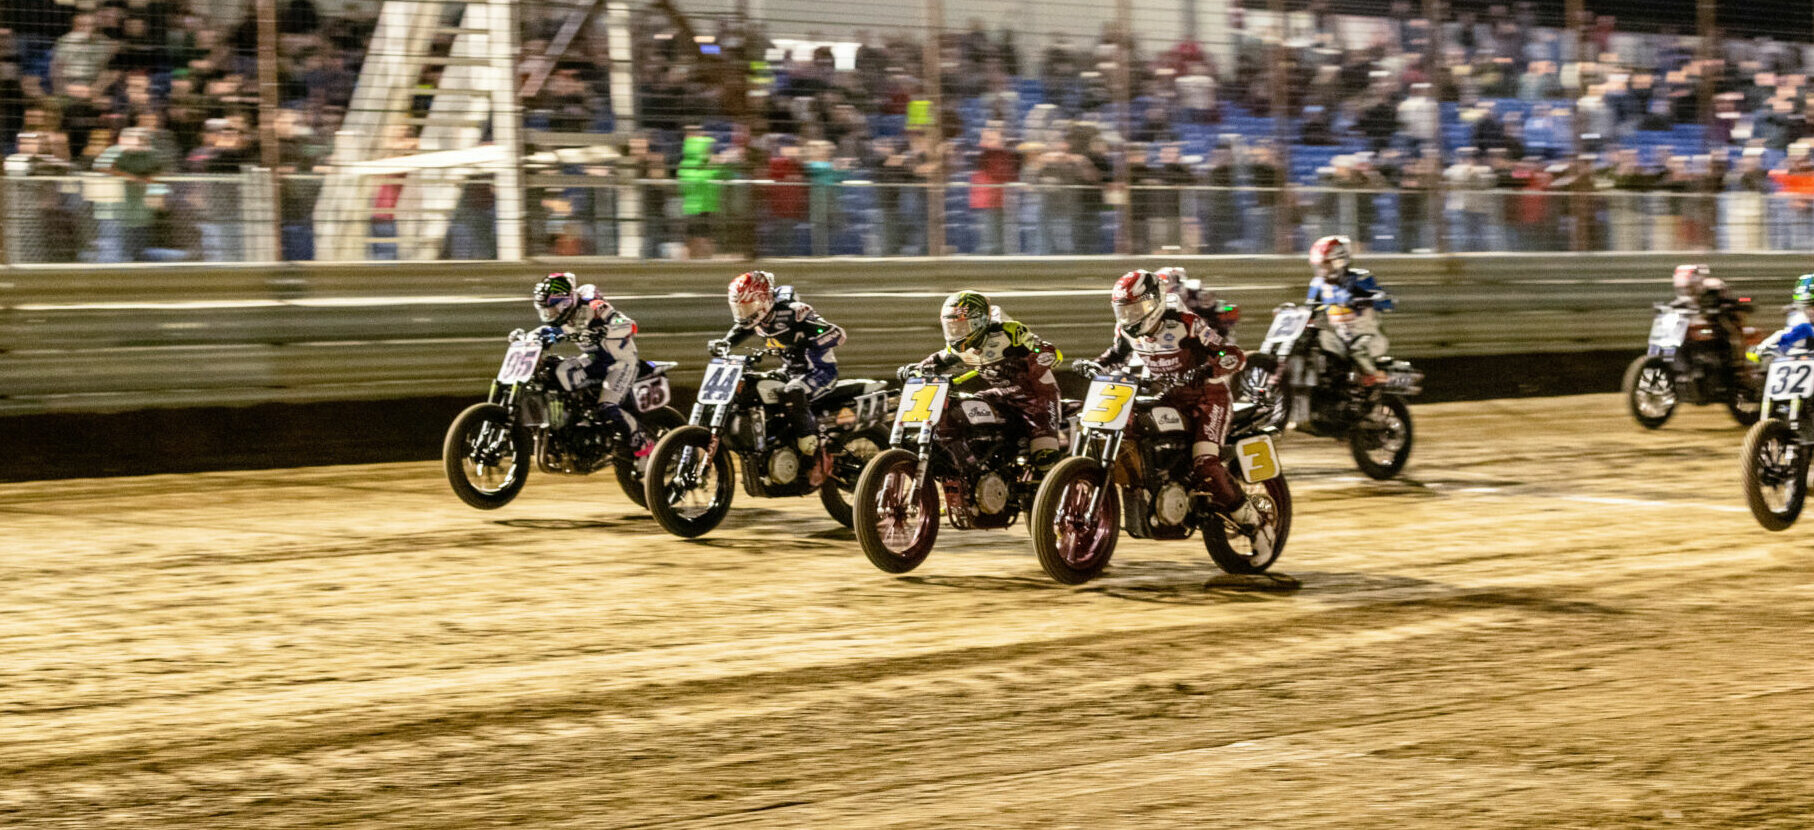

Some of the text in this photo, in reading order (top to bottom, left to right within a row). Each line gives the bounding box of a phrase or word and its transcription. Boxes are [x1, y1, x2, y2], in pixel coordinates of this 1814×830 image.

[702, 366, 739, 400] 44
[1771, 365, 1811, 395] 32
[901, 384, 940, 422] 1
[1082, 383, 1134, 423] 3
[1242, 441, 1276, 481] 3
